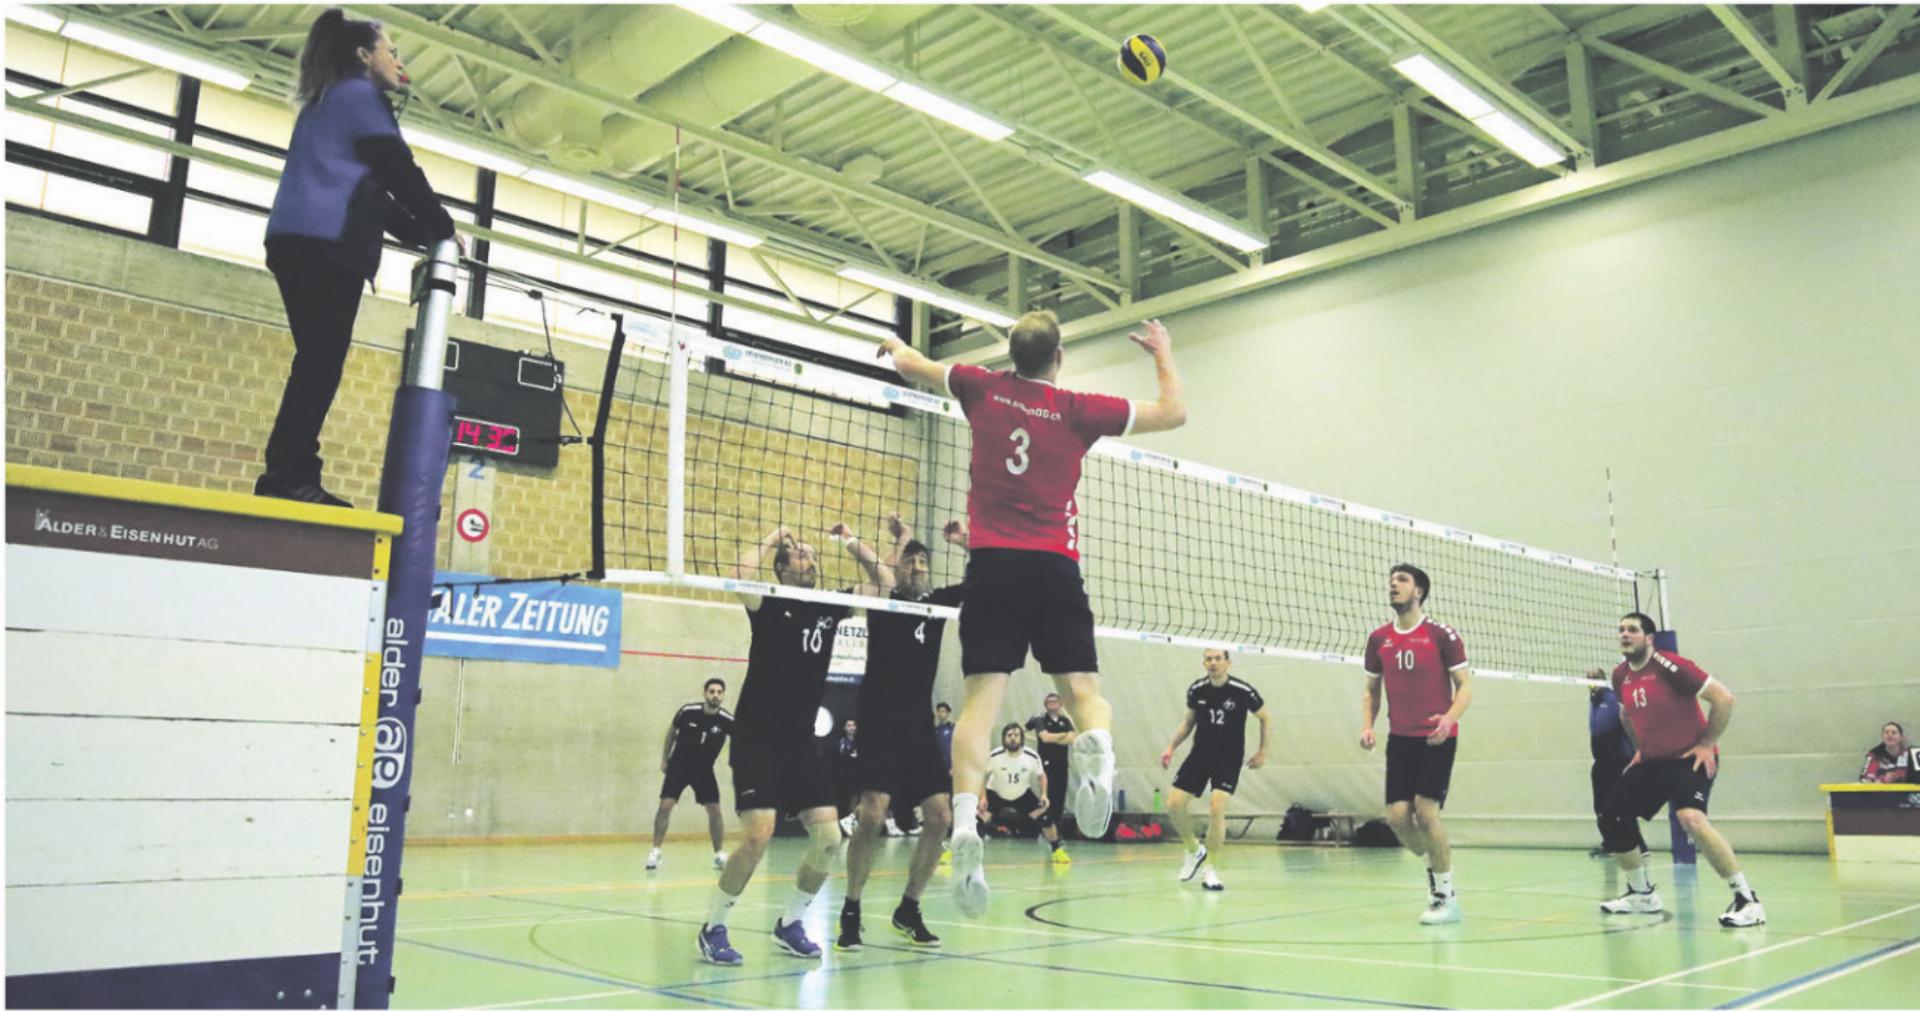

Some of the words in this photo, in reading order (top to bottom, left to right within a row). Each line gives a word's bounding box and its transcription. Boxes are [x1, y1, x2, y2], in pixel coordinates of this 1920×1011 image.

[1006, 427, 1030, 475] 3
[36, 516, 97, 537] ALDER
[110, 524, 196, 548] EISENHUT
[502, 591, 611, 638] ZEITUNG
[802, 628, 823, 654] 10
[914, 621, 926, 645] 4
[379, 617, 409, 708] alder
[1395, 649, 1415, 670] 10
[1632, 687, 1648, 708] 13
[1209, 708, 1225, 725] 12
[1007, 773, 1020, 785] 15
[357, 802, 391, 966] eisenhut
